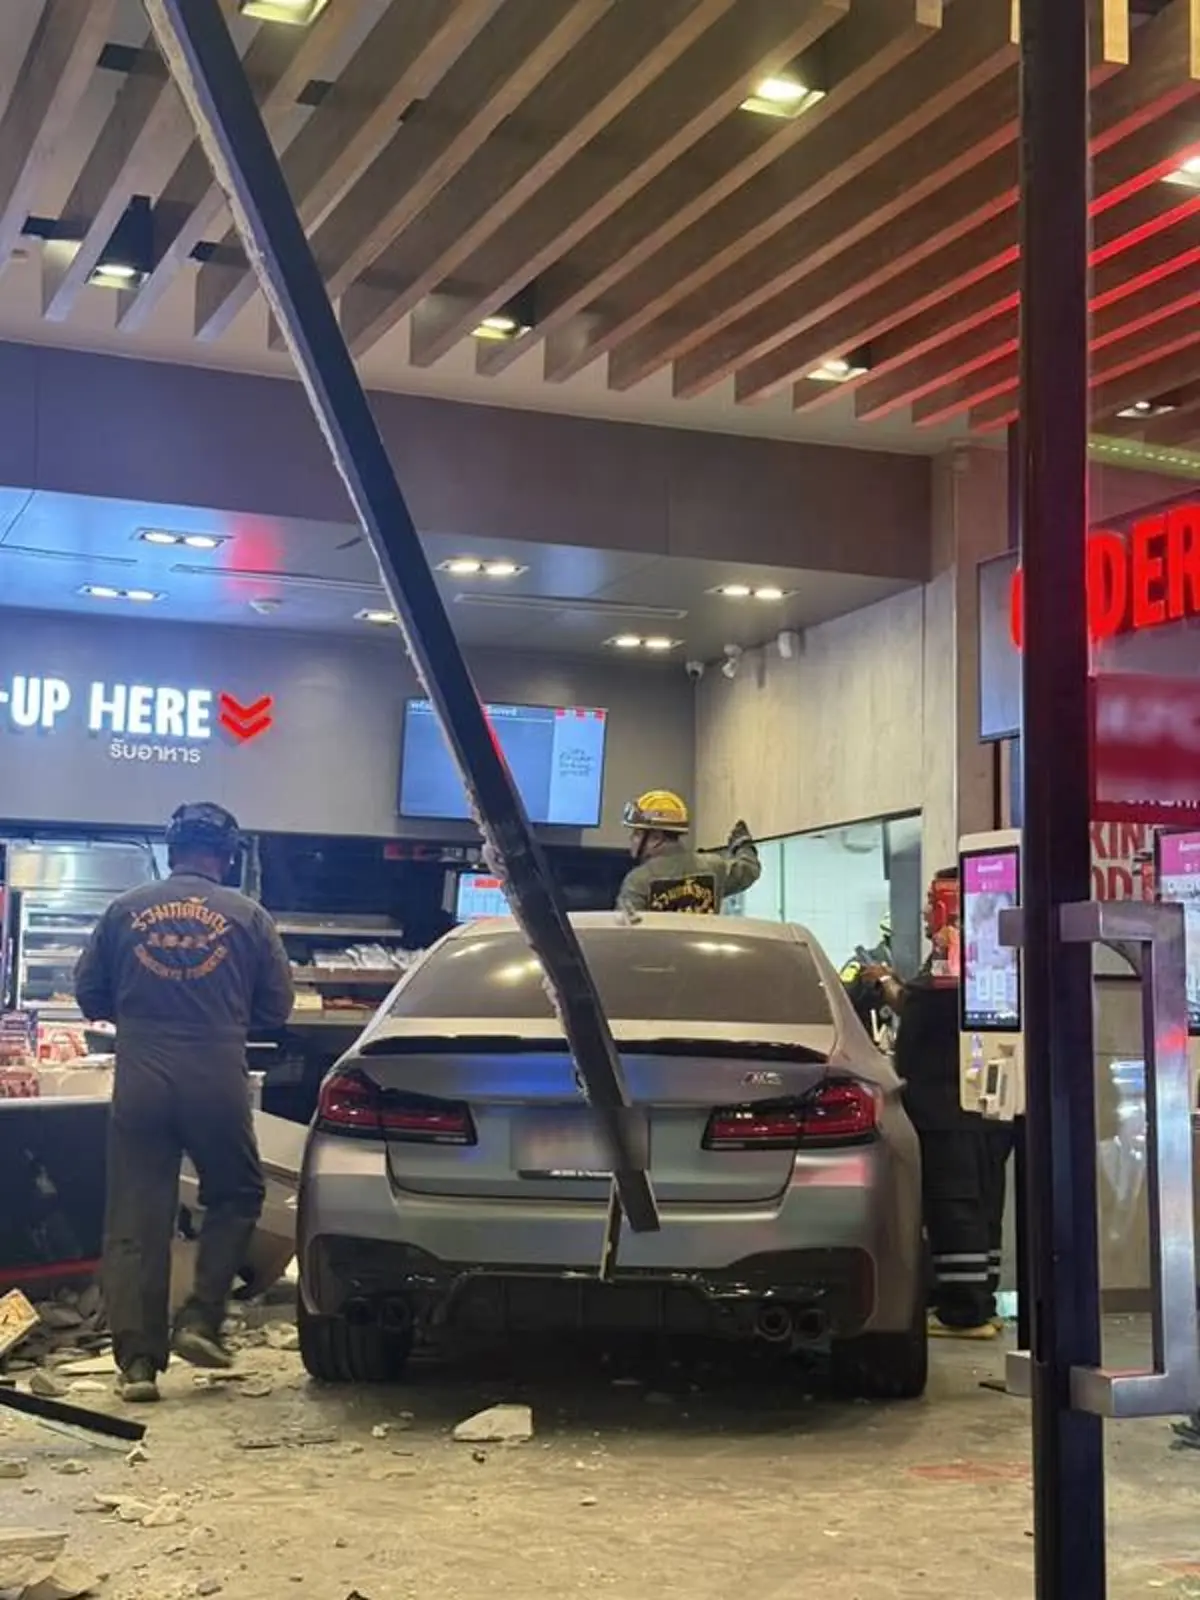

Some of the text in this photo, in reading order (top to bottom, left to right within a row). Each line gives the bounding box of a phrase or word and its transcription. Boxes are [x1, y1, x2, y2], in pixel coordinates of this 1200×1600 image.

[88, 681, 212, 738] HERE
[110, 738, 201, 763] รับอาหาร
